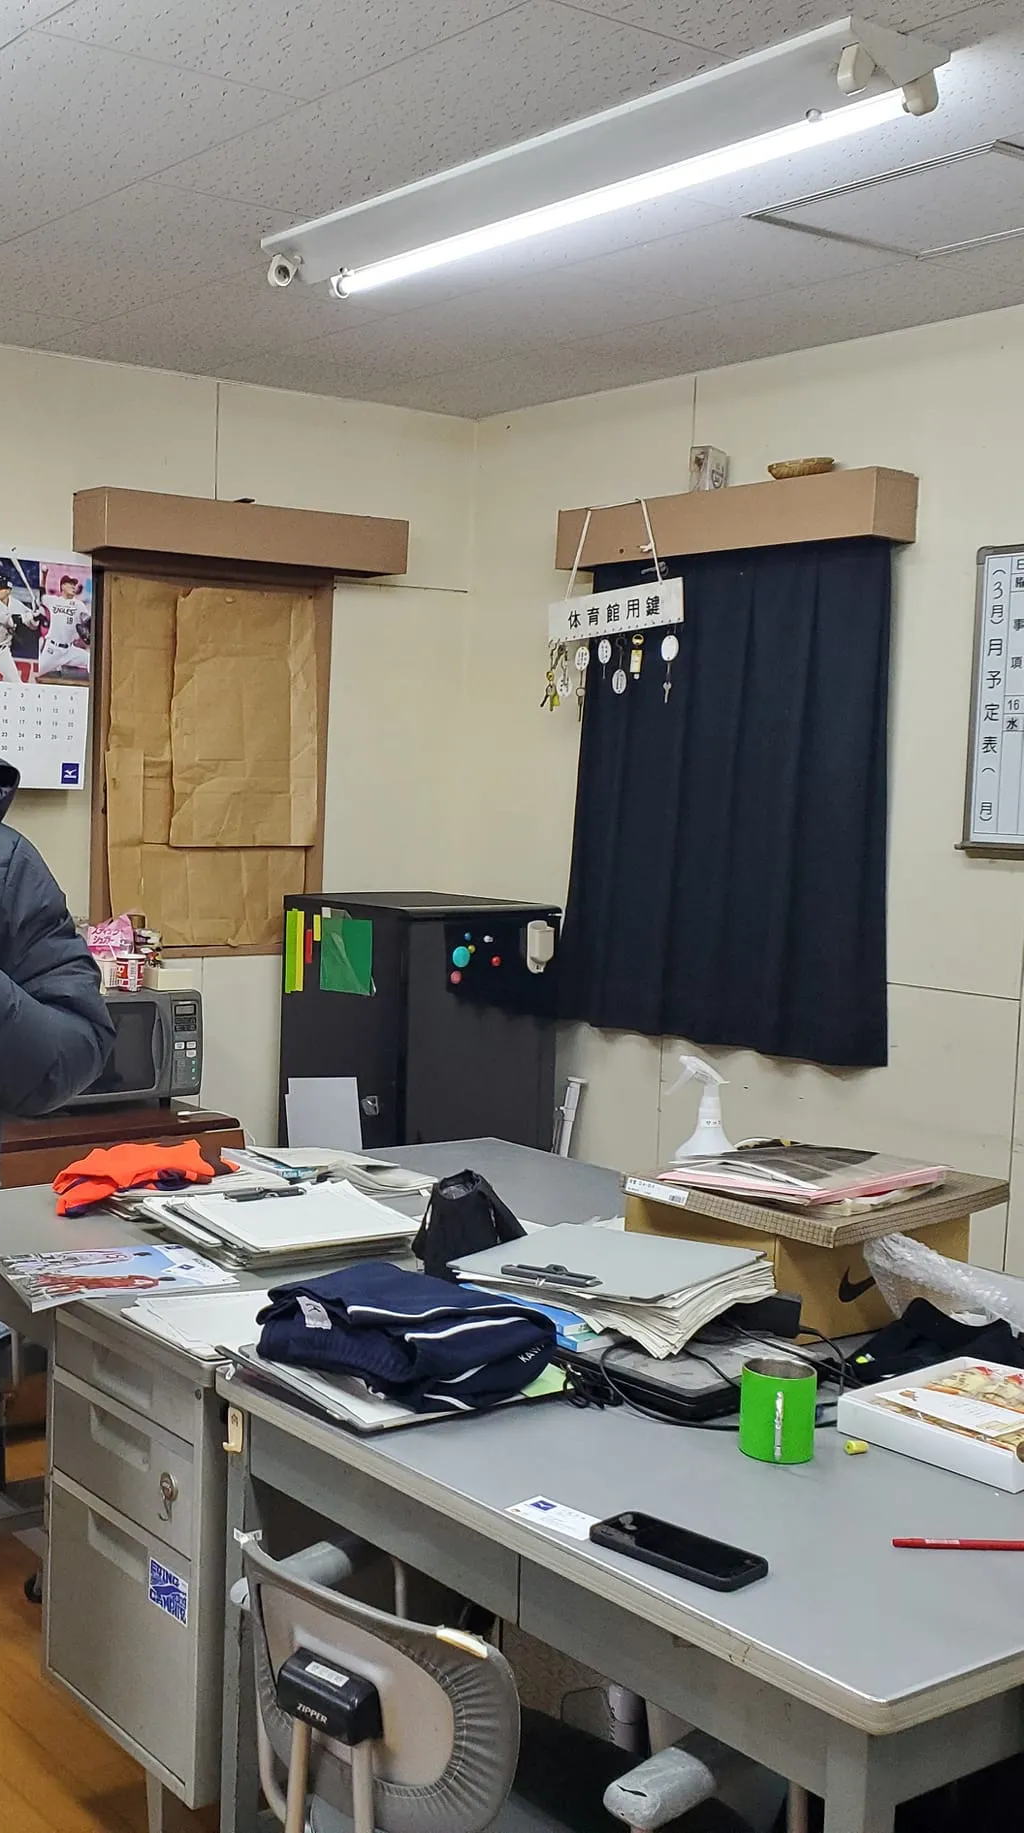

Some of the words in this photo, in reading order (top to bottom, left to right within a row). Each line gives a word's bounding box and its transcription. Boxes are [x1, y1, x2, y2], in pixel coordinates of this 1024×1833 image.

[567, 595, 661, 630] 体育館用鍵
[1007, 700, 1020, 711] 16
[1006, 718, 1018, 730] 水
[296, 1702, 328, 1724] ZIPPER
